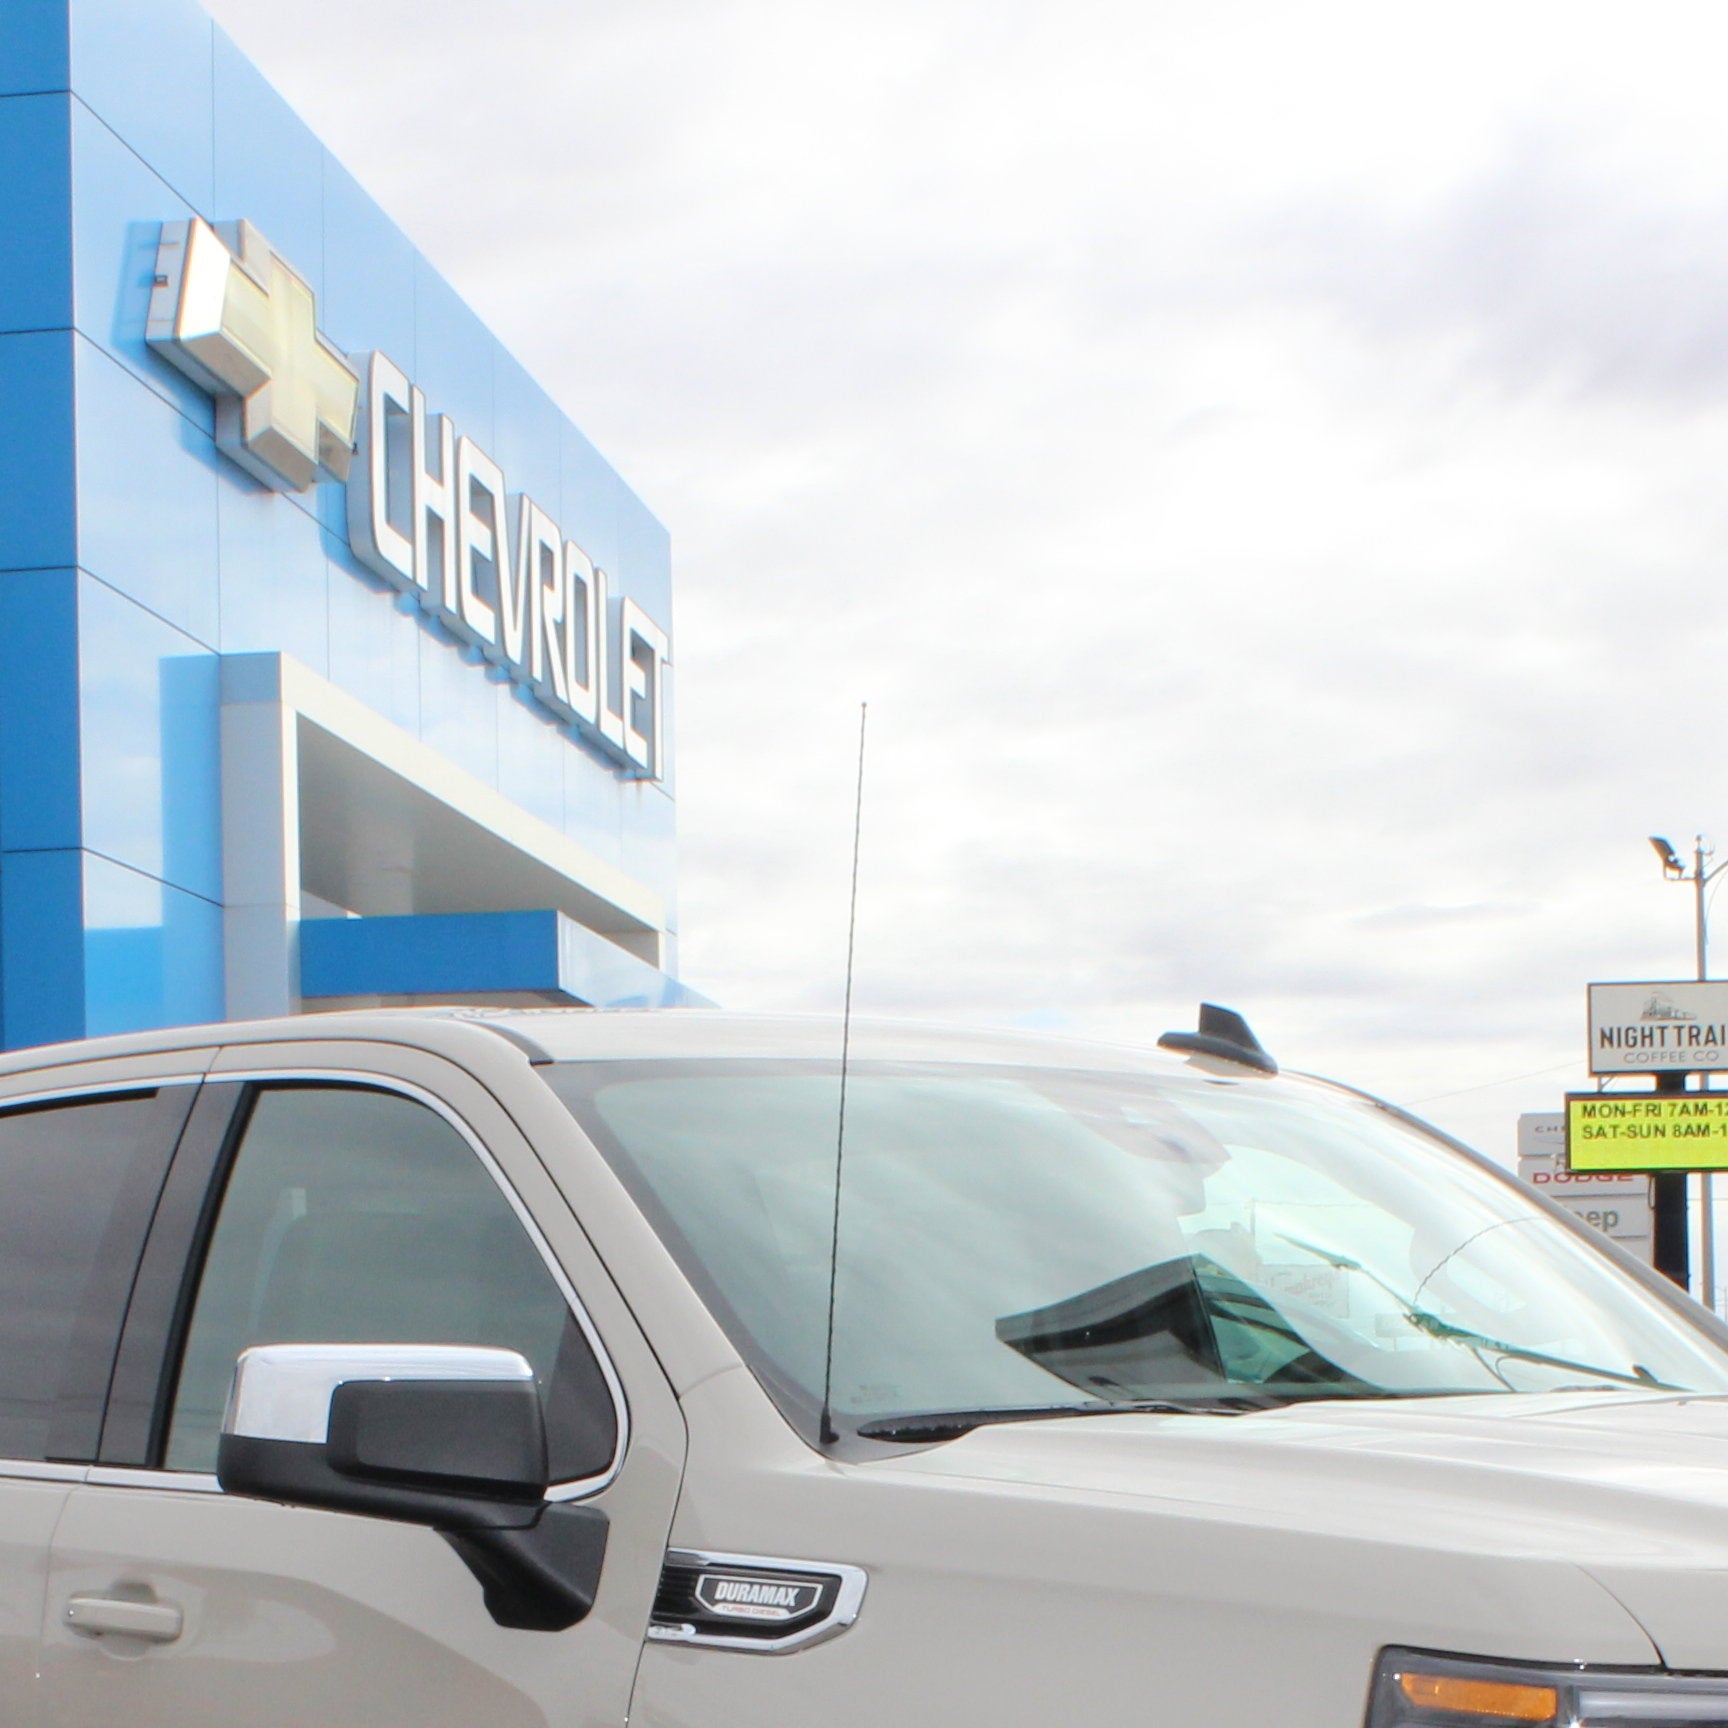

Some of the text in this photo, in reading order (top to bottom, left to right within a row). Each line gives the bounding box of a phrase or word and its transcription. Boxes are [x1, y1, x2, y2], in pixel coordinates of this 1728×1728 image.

[348, 349, 672, 783] CHEVROLET
[1598, 1025, 1670, 1049] NIGHT
[1623, 1050, 1720, 1064] COFFEE CO
[1582, 1103, 1662, 1118] MON-FRI
[1582, 1124, 1666, 1140] SAT-SUN
[714, 1581, 800, 1607] DURAMAX
